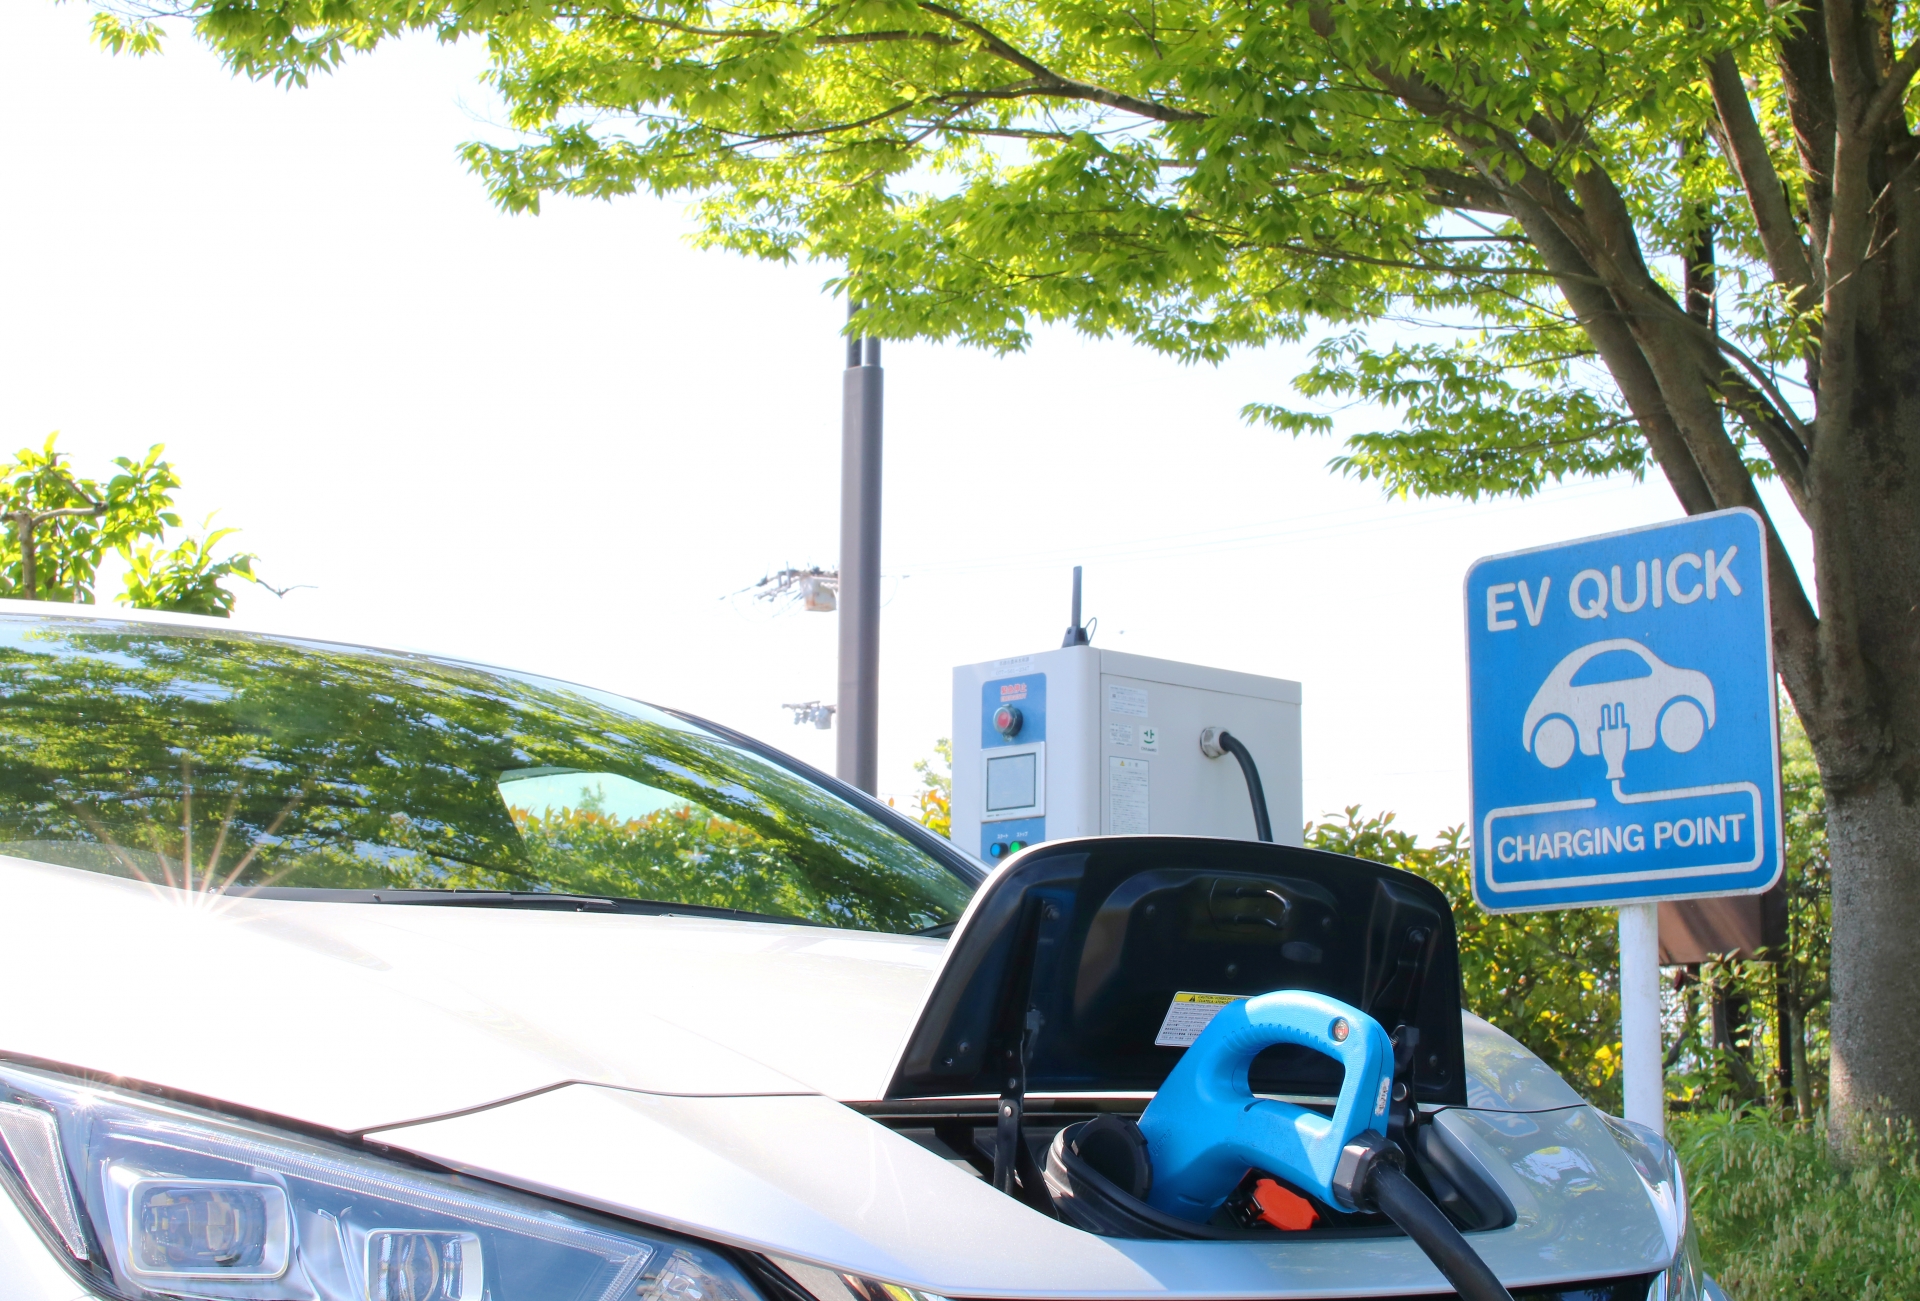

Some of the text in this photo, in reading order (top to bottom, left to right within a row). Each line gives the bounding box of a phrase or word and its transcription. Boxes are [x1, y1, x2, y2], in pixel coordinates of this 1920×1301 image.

[1487, 545, 1742, 632] EV QUICK
[1001, 683, 1027, 695] 緊急停止
[1498, 814, 1746, 863] CHARGING POINT
